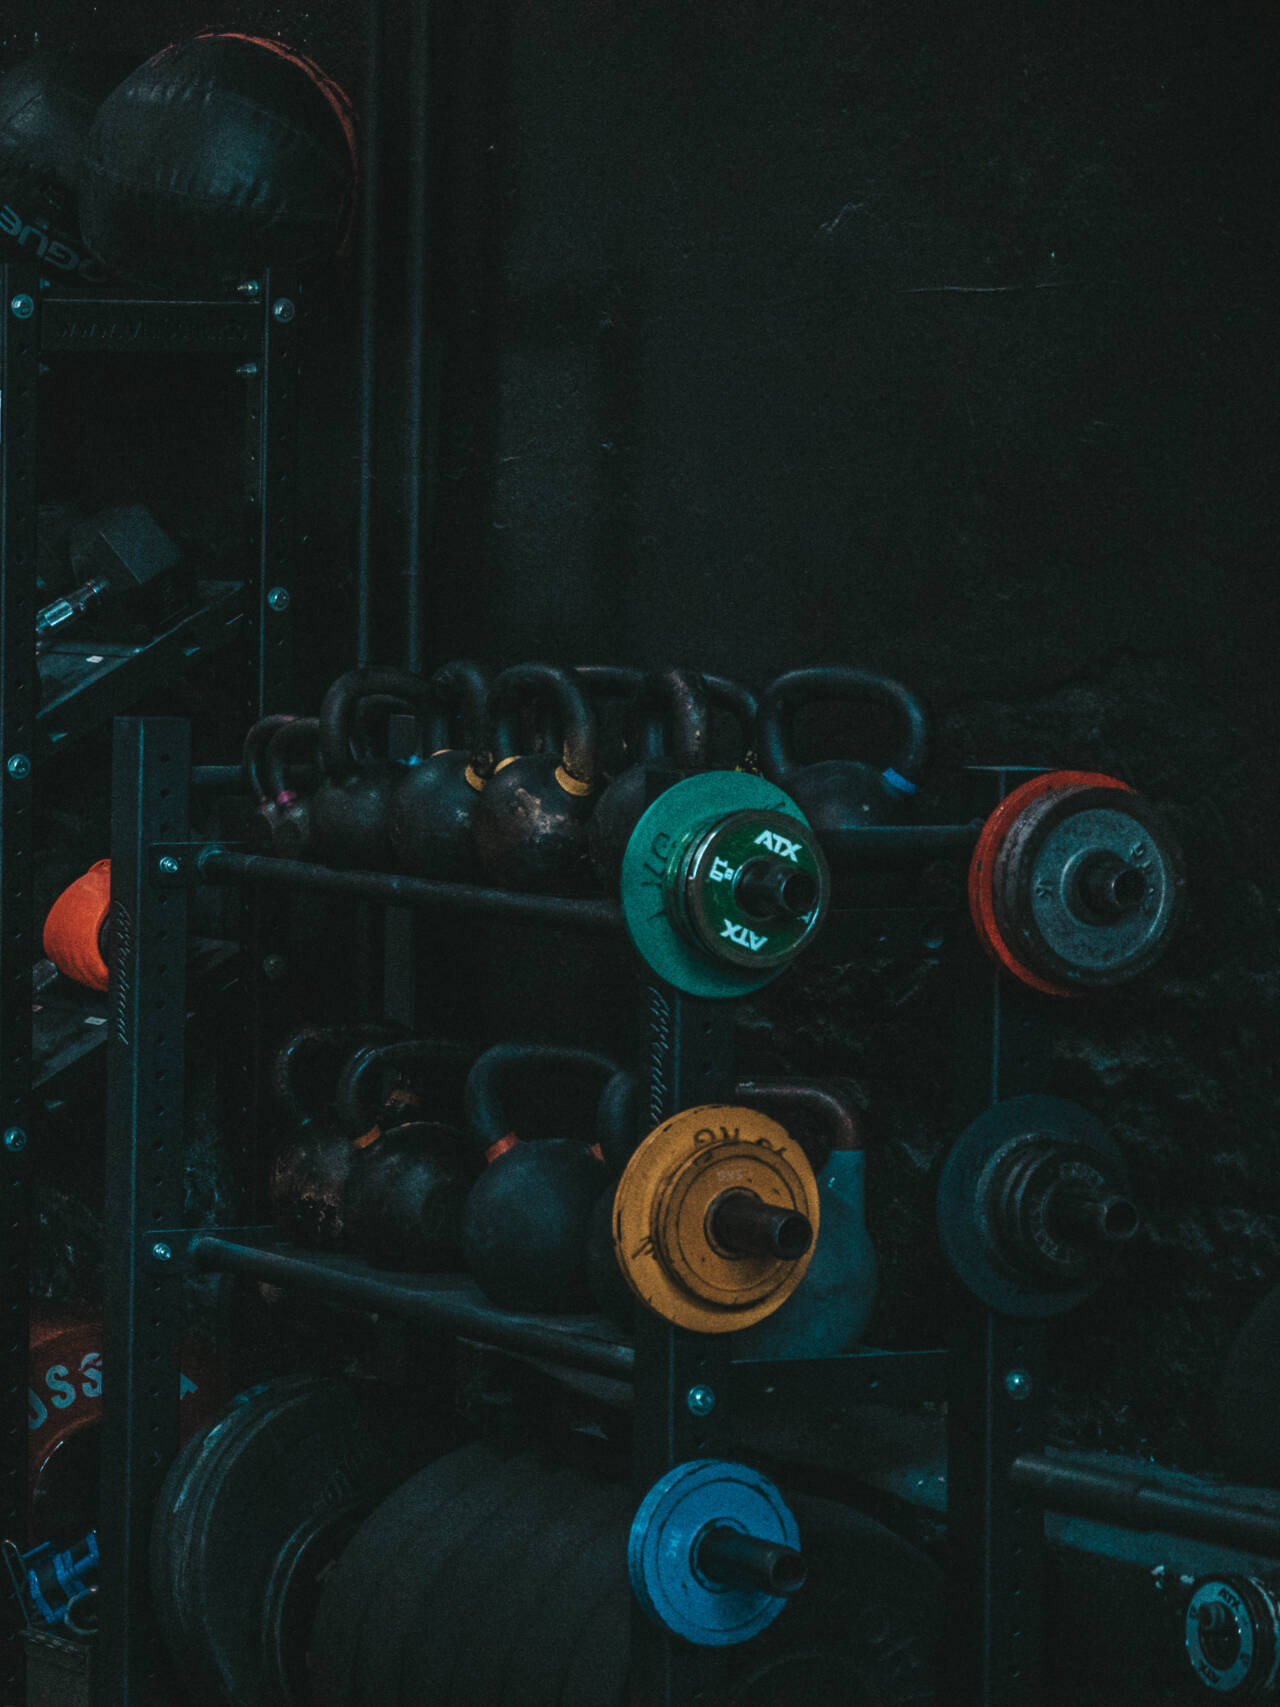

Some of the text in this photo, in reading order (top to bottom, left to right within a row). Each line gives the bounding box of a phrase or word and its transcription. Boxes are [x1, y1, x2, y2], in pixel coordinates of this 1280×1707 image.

[754, 829, 803, 863] ATX
[719, 917, 769, 951] ATX
[1217, 1587, 1240, 1610] ATX
